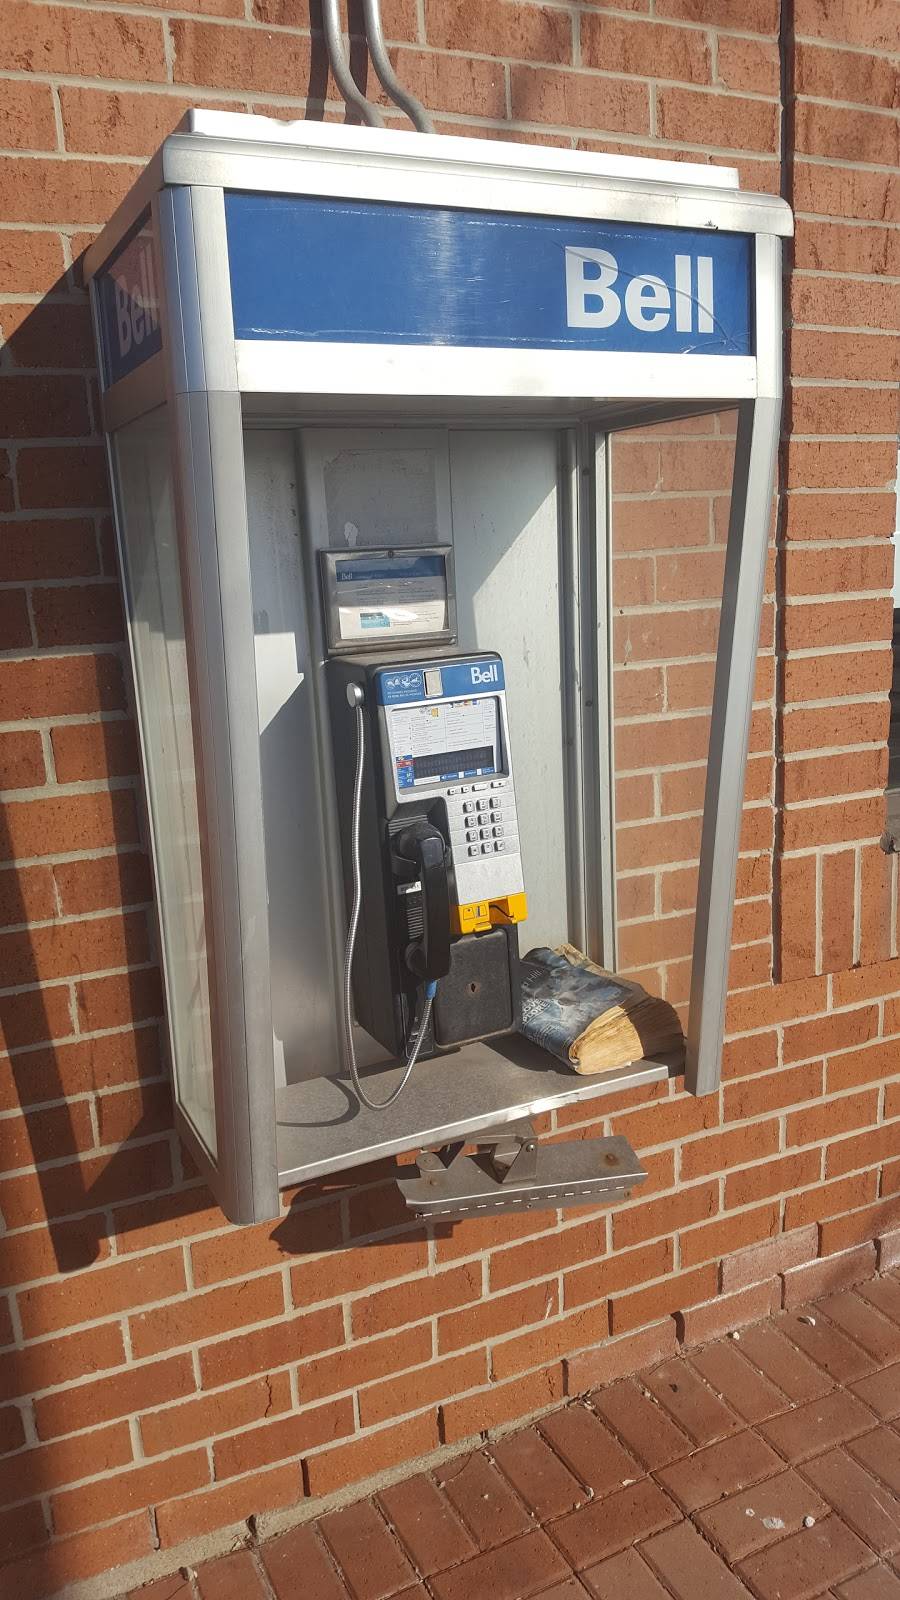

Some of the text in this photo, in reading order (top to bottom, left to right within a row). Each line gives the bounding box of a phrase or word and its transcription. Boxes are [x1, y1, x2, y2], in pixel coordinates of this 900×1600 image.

[115, 242, 158, 358] Bell
[565, 246, 714, 333] Bell
[470, 664, 499, 685] Bell
